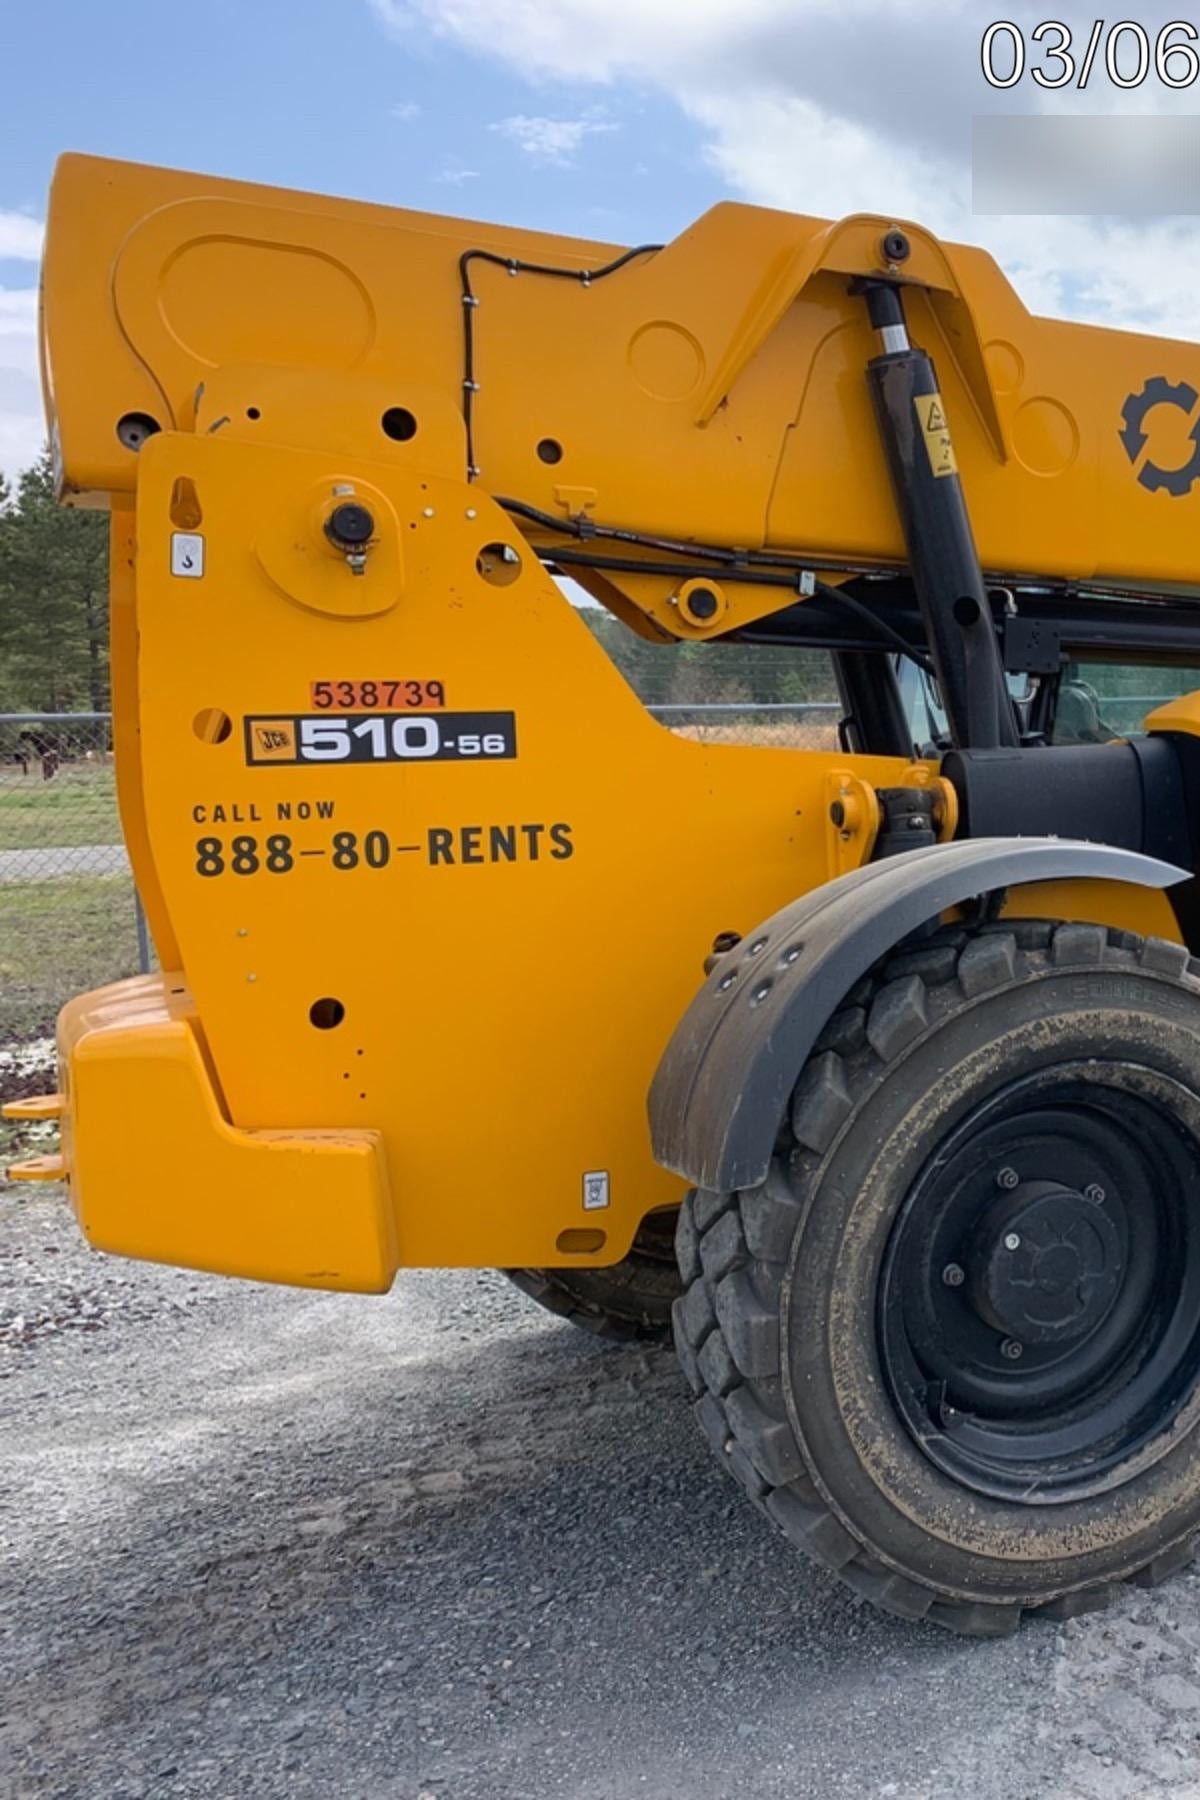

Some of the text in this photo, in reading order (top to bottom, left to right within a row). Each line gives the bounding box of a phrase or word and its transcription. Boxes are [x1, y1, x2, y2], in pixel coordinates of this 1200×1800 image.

[313, 681, 445, 709] 538739
[300, 716, 506, 760] 510-56
[192, 801, 335, 823] CALL NOW
[195, 823, 574, 877] 888-80-RENTS
